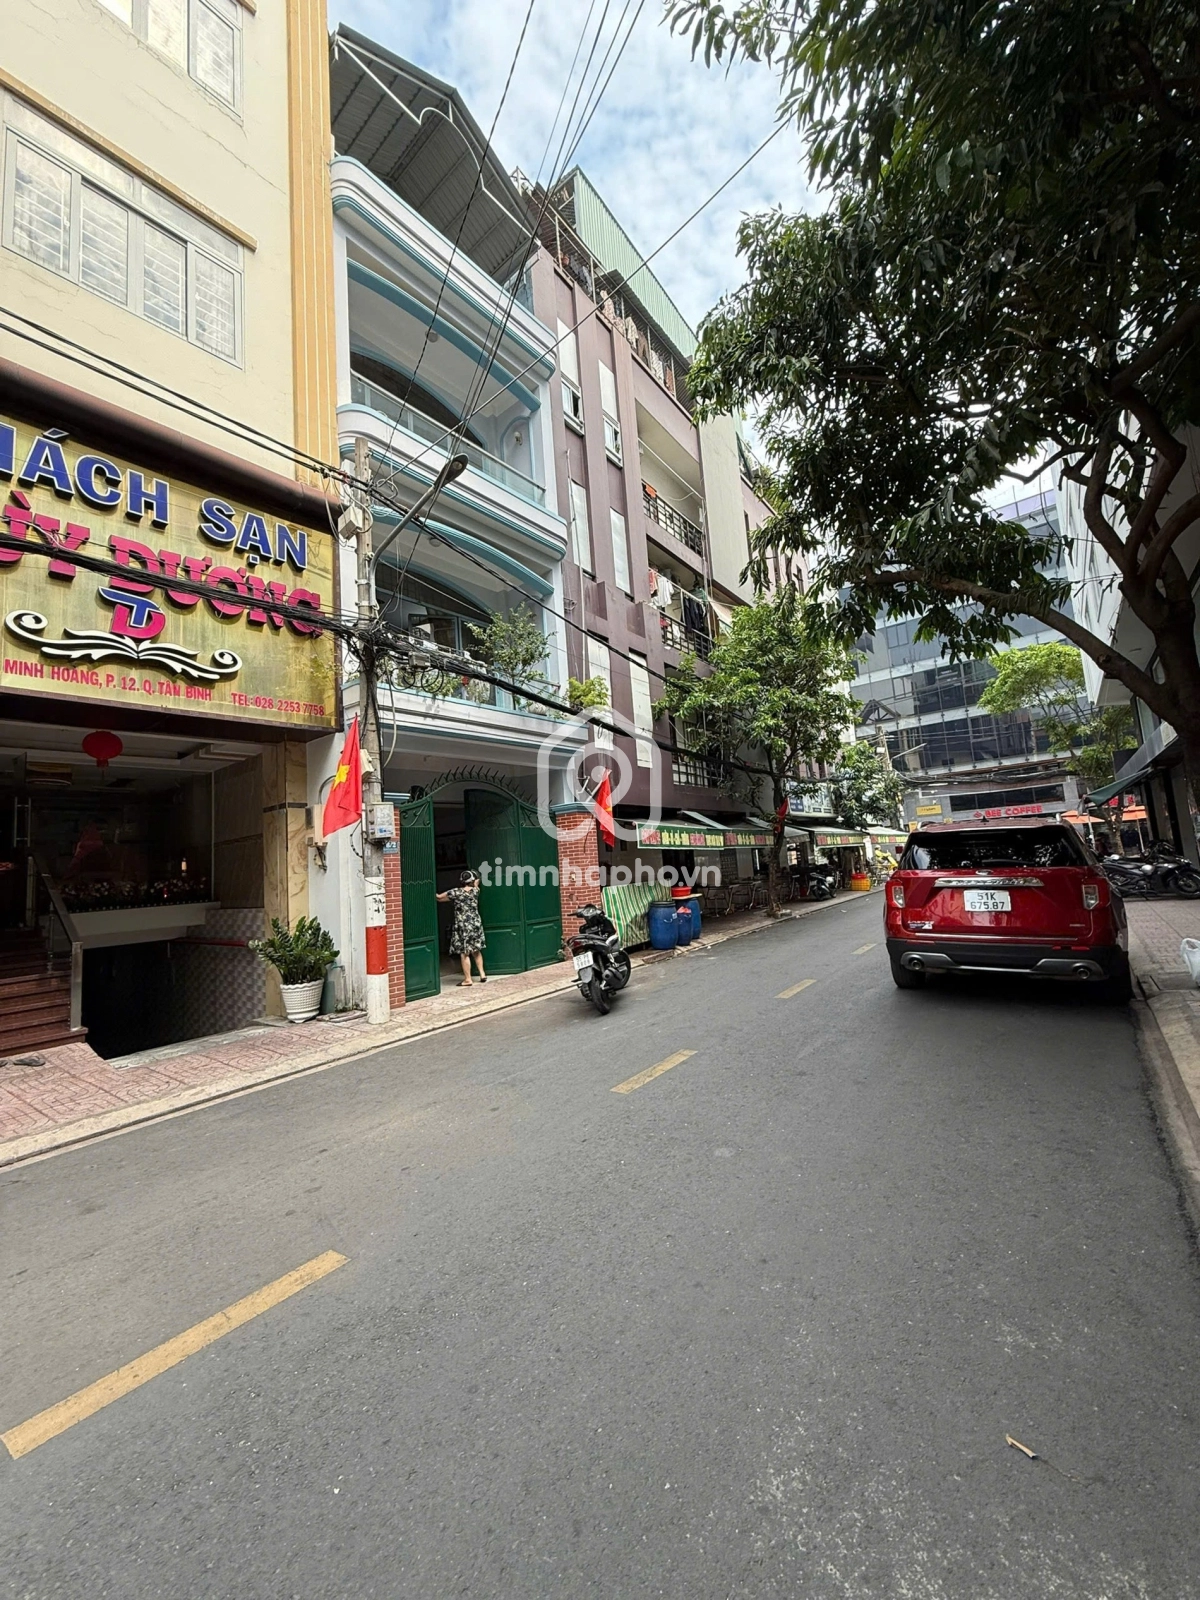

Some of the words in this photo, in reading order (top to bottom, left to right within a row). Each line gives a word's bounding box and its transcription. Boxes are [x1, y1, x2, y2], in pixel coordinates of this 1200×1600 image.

[199, 497, 308, 572] SẠN
[4, 658, 44, 679] MINH
[105, 673, 117, 688] P.
[121, 676, 140, 692] 12.
[158, 679, 181, 698] TÂN
[277, 699, 301, 713] 2253
[303, 703, 325, 716] 7758
[985, 808, 1002, 818] BEE
[1005, 805, 1043, 816] COFFEE
[977, 892, 997, 901] 51K
[970, 901, 1005, 910] 675.87
